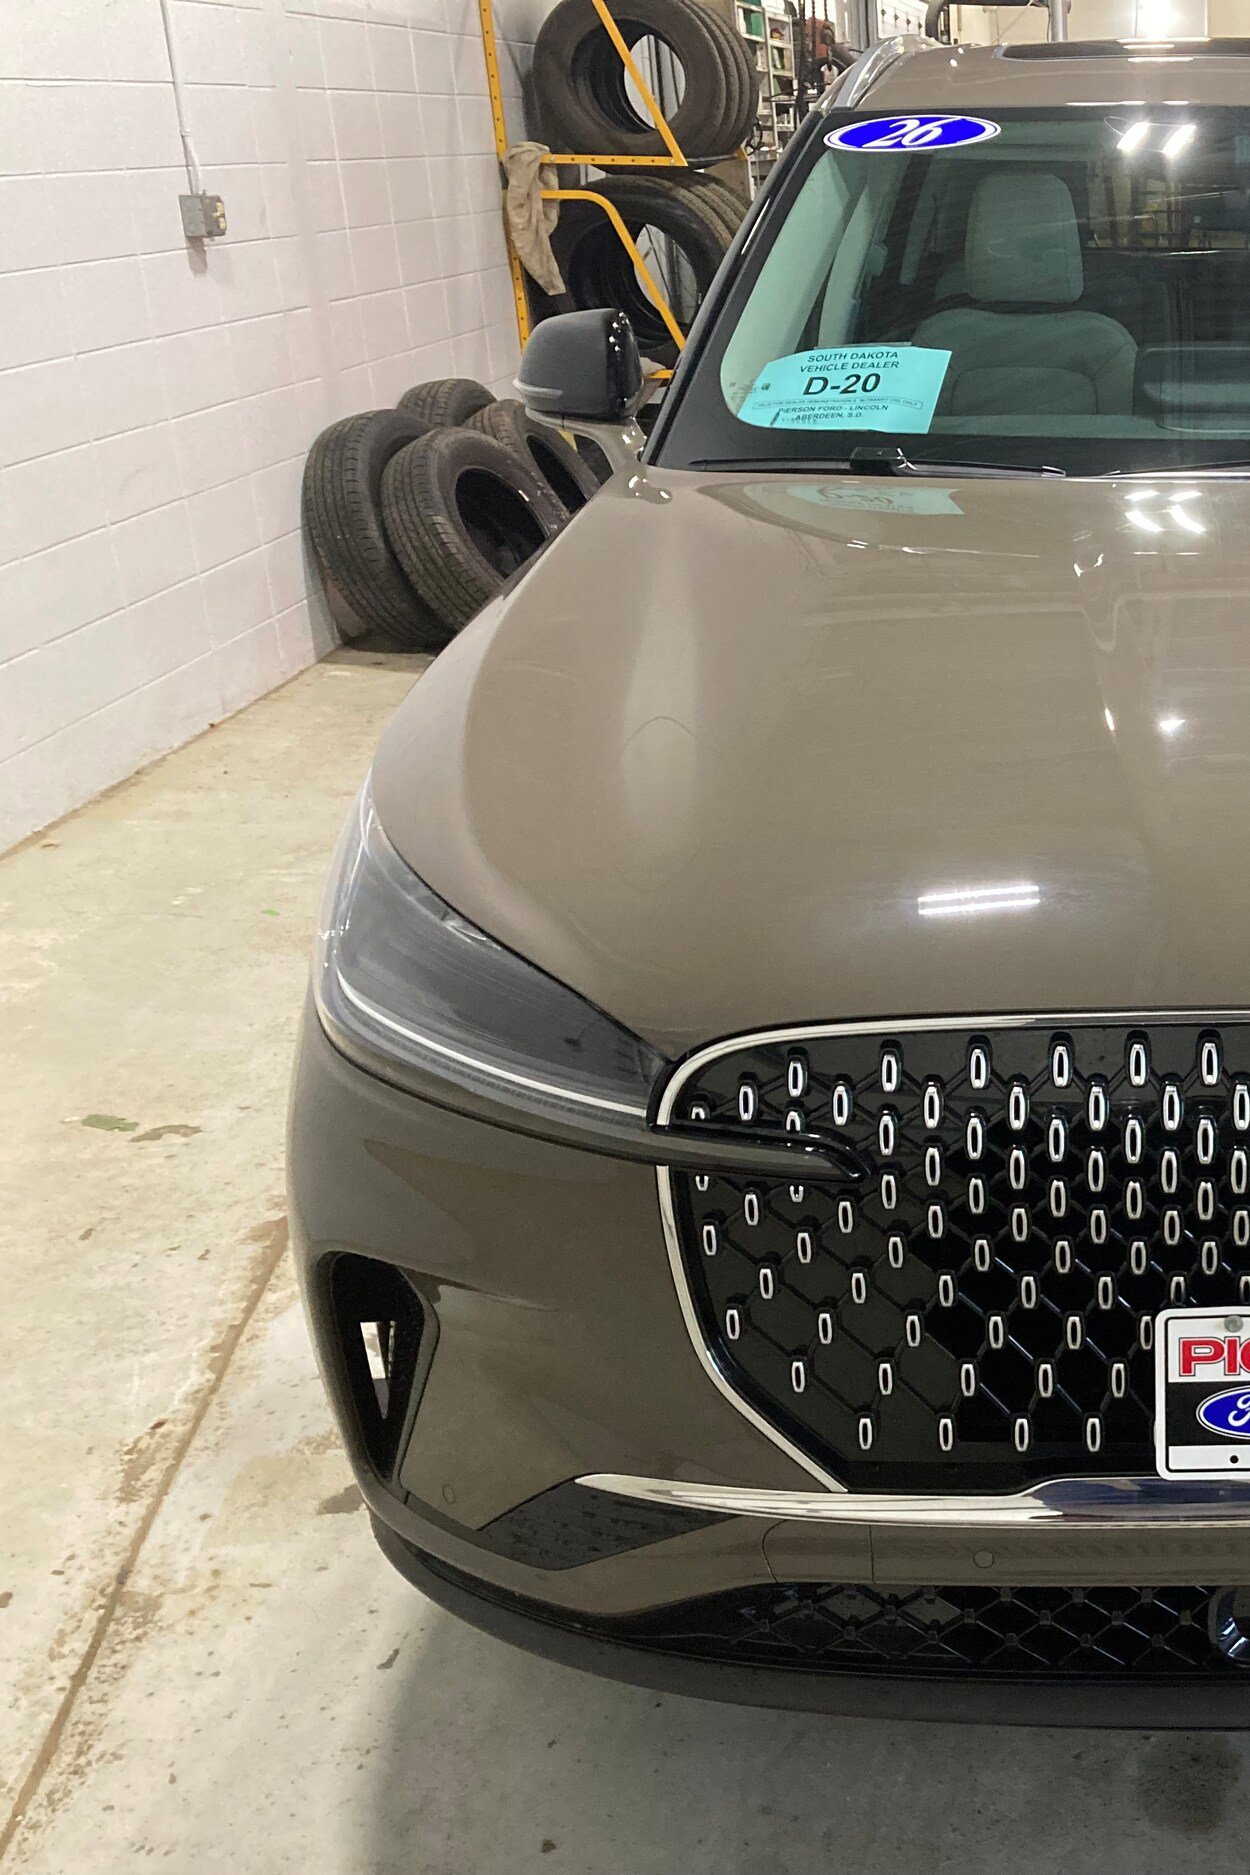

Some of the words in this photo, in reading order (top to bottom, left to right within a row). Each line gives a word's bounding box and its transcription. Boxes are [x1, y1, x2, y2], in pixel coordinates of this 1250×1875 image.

[861, 117, 963, 148] 26
[807, 353, 847, 362] SOUTH
[850, 351, 898, 360] DAKOTA
[800, 362, 849, 373] VEHICLE
[851, 361, 899, 370] DEALER
[803, 373, 881, 395] D-20
[779, 406, 816, 414] PIERSON
